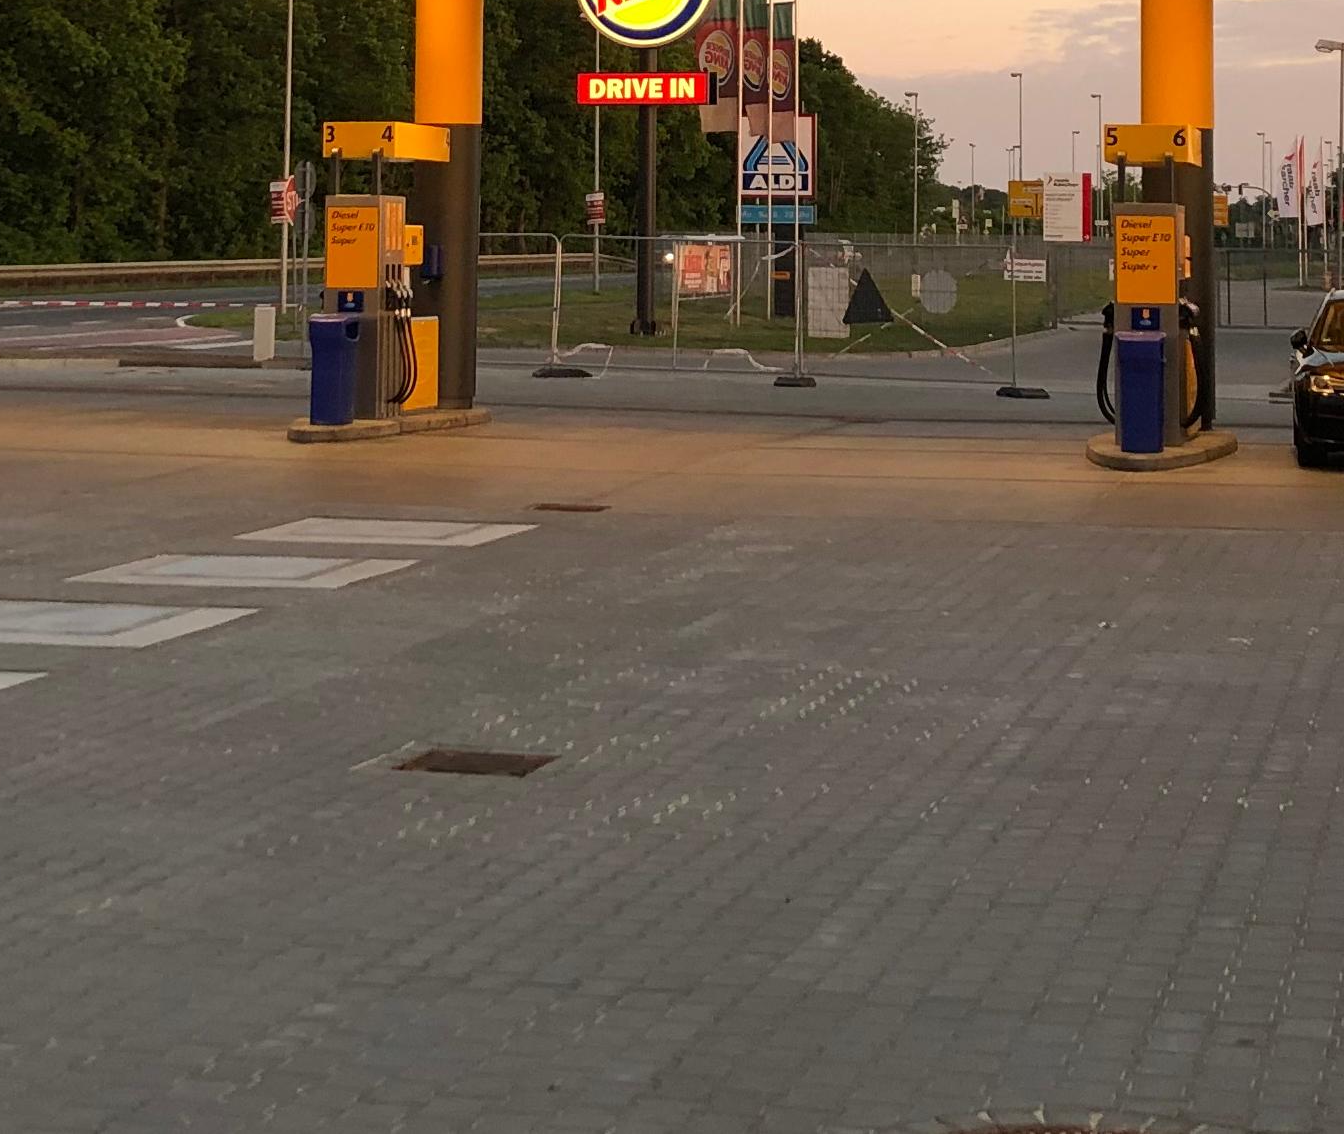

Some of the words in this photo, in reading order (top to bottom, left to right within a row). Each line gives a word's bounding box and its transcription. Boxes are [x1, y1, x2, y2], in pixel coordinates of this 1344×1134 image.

[589, 77, 664, 99] DRIVE
[670, 77, 695, 99] IN
[325, 125, 336, 143] 3
[381, 125, 394, 143] 4
[1106, 127, 1118, 146] 5
[1173, 128, 1186, 147] 6
[749, 174, 802, 190] ALDI
[331, 209, 359, 219] Diesel
[331, 222, 357, 233] Super
[359, 222, 375, 231] E10
[1121, 219, 1152, 229] Diesel
[331, 235, 357, 246] Super
[1121, 233, 1151, 244] Super
[1152, 233, 1172, 242] E10
[1120, 247, 1150, 258] Super
[1121, 261, 1150, 272] Super
